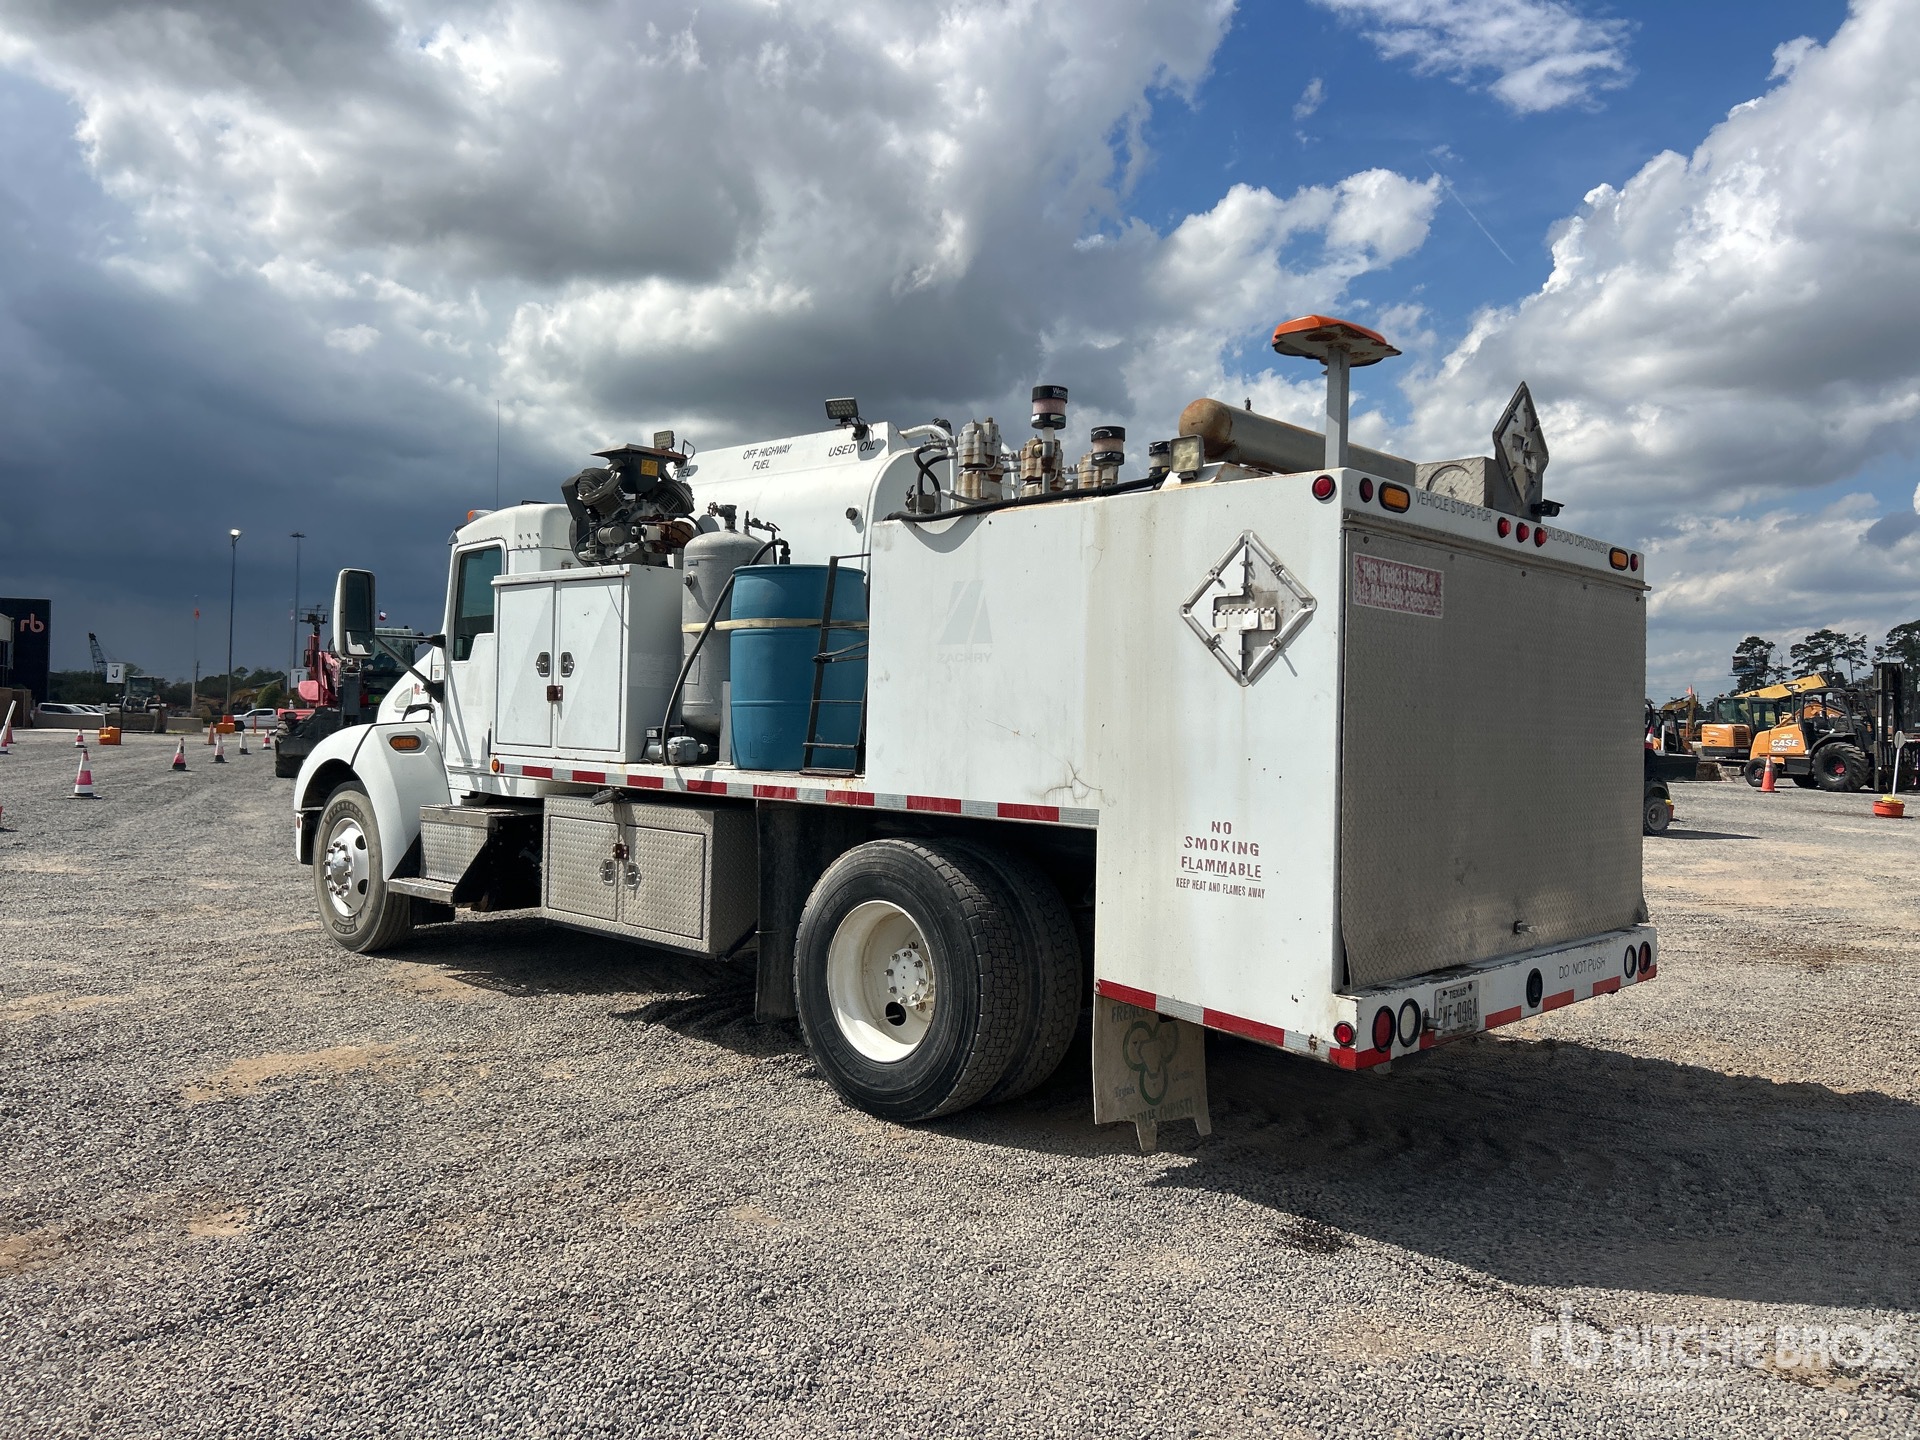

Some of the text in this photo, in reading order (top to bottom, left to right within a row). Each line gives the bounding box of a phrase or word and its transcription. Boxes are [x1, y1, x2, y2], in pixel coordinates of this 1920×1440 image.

[743, 444, 792, 460] OFF HIGHWAY
[828, 440, 875, 457] USED OIL
[671, 467, 691, 479] FUEL
[752, 459, 770, 470] FUEL
[1416, 490, 1492, 523] VEHICLE STOPS FOR
[1575, 535, 1608, 554] CROSSINGS
[20, 613, 45, 632] rb
[111, 668, 119, 679] J
[1771, 739, 1799, 747] CASE
[1211, 821, 1232, 835] NO
[1184, 836, 1260, 857] SMOKING
[1181, 856, 1262, 878] FLAMMABLE
[1176, 877, 1266, 899] KEEP HEAT AND FLAMES AWAY
[1559, 956, 1606, 979] DO NOT PUSH
[1449, 987, 1467, 1000] TEXAS
